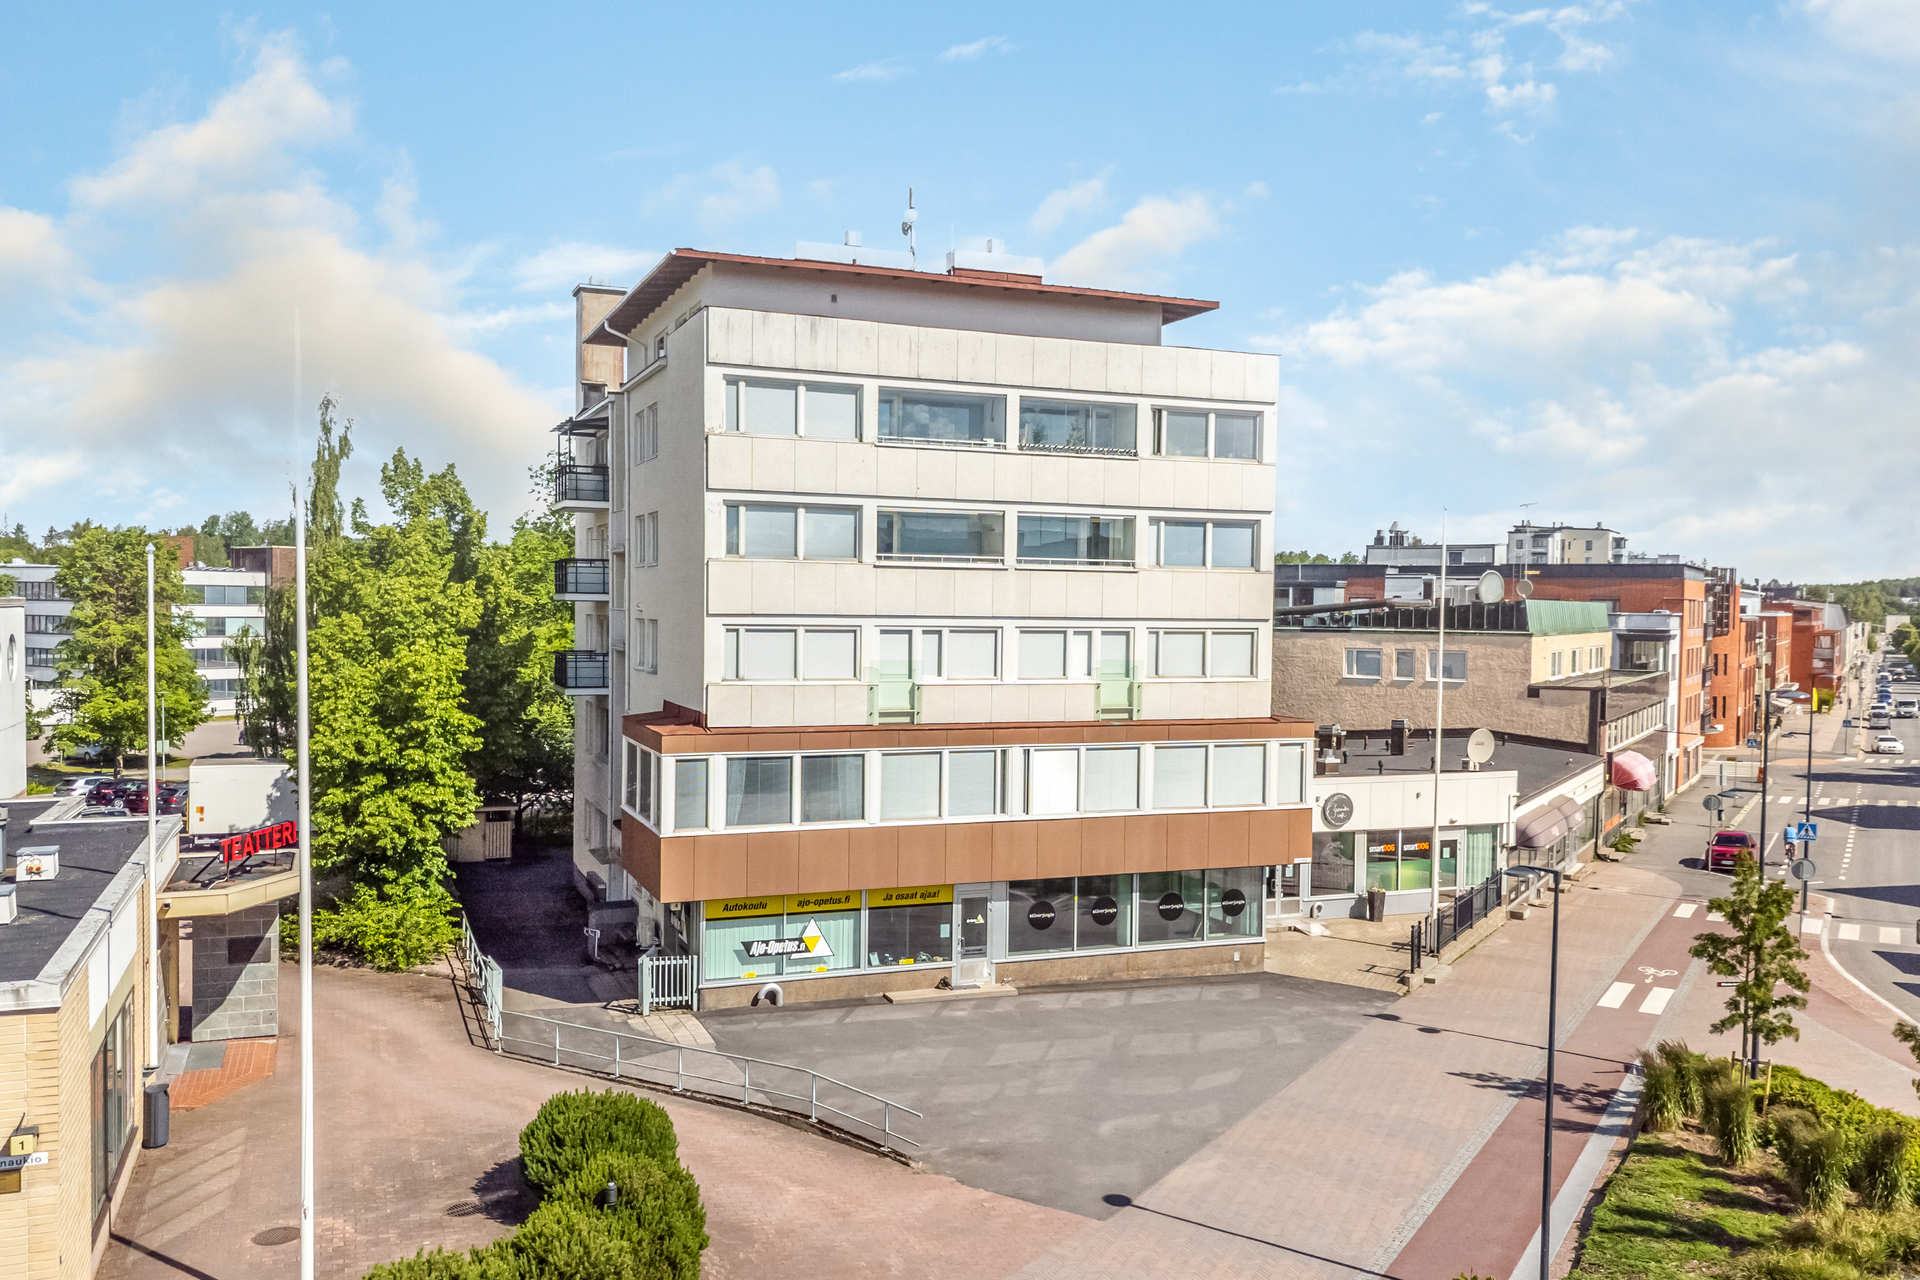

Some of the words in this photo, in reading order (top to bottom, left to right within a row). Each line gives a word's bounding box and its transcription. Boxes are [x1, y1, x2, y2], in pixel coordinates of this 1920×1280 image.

[221, 821, 297, 864] TEATTERI
[1403, 842, 1430, 851] smartDOG
[1369, 844, 1396, 853] smartDOG
[883, 893, 893, 901] Ja
[895, 891, 918, 900] osaat
[919, 890, 940, 900] ajaa!
[722, 901, 768, 912] Autokoulu
[797, 895, 851, 909] ajo-opetus.fi
[749, 940, 806, 957] Ajo-Opetus.fi
[18, 1141, 24, 1150] 1
